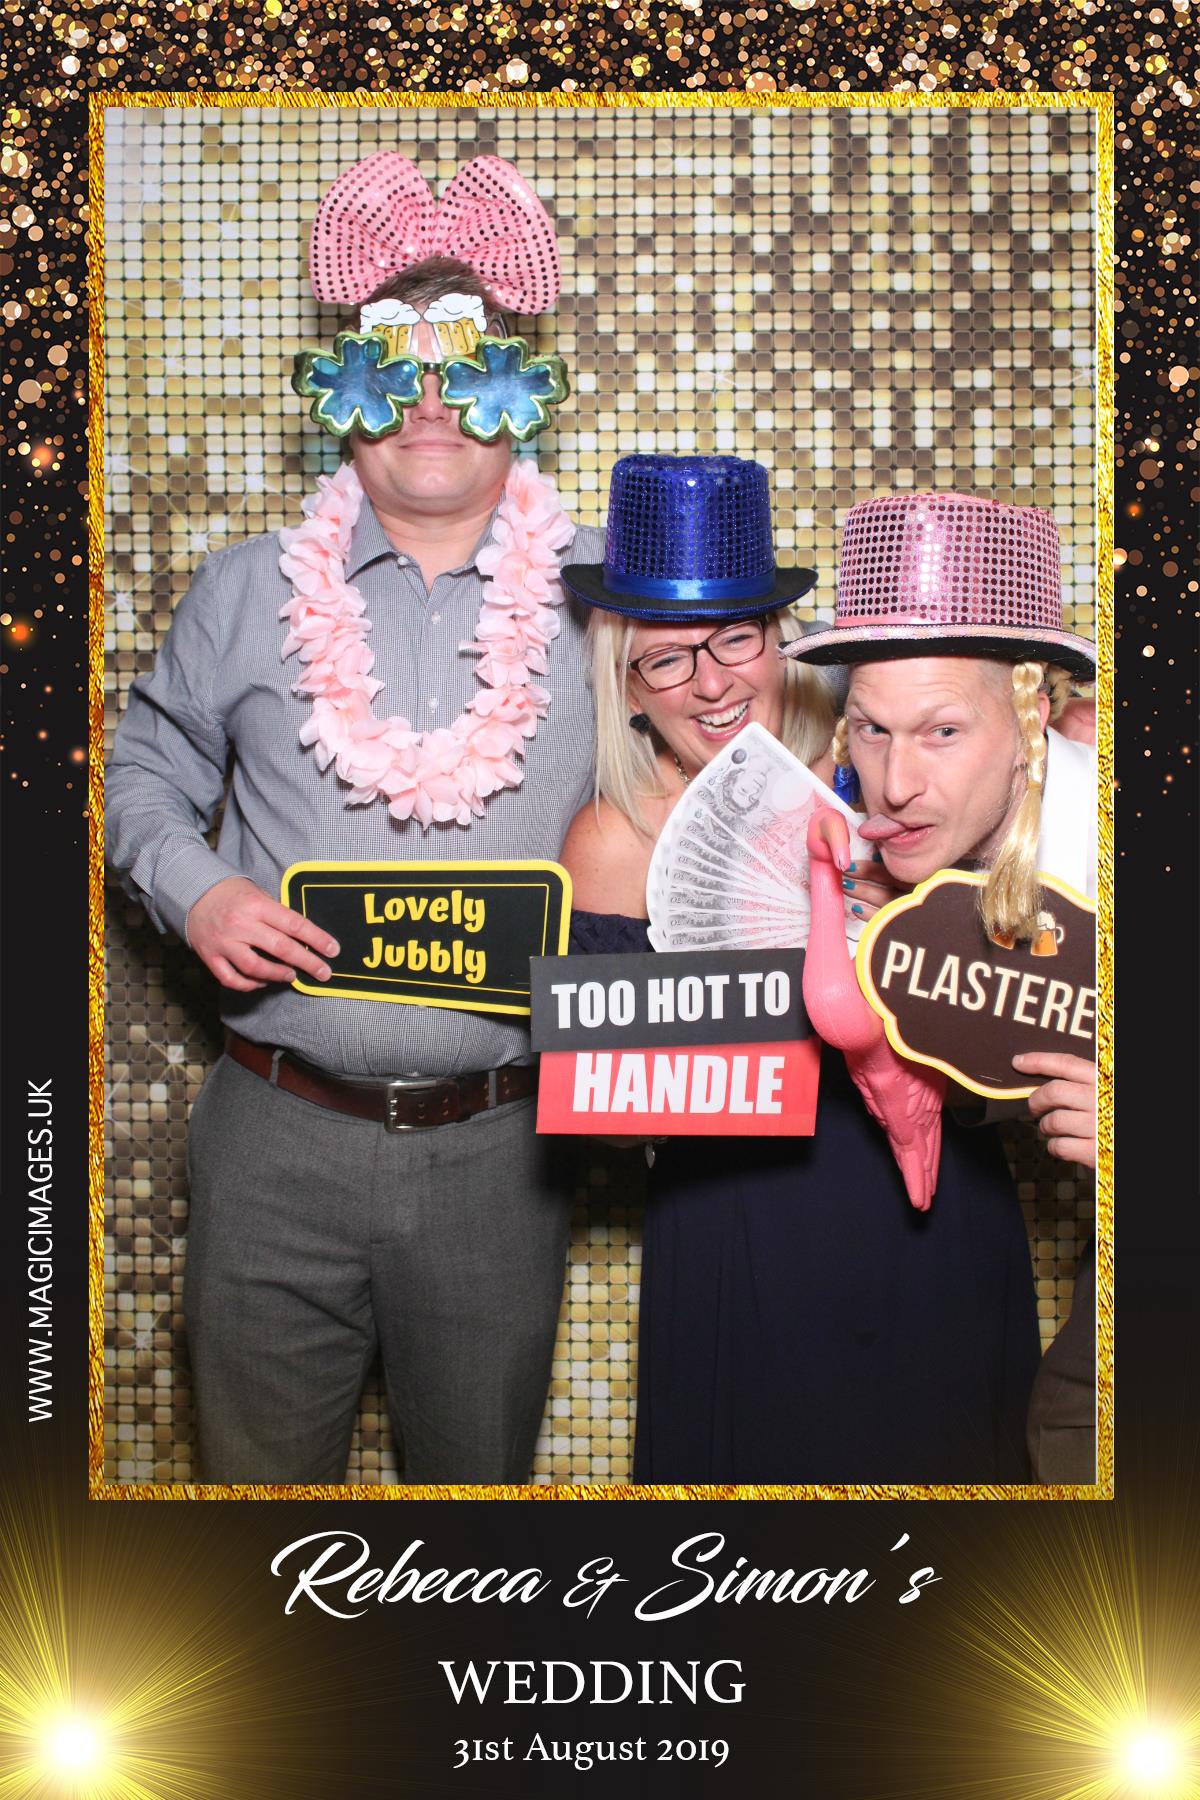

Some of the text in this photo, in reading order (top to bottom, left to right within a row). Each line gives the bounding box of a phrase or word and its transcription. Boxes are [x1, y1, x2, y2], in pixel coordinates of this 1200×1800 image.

[364, 890, 486, 933] Lovely
[363, 937, 487, 984] Jubbly
[551, 971, 791, 1029] TOO HOT TO
[881, 940, 1096, 1040] PLASTERE
[572, 1053, 785, 1114] HANDLE
